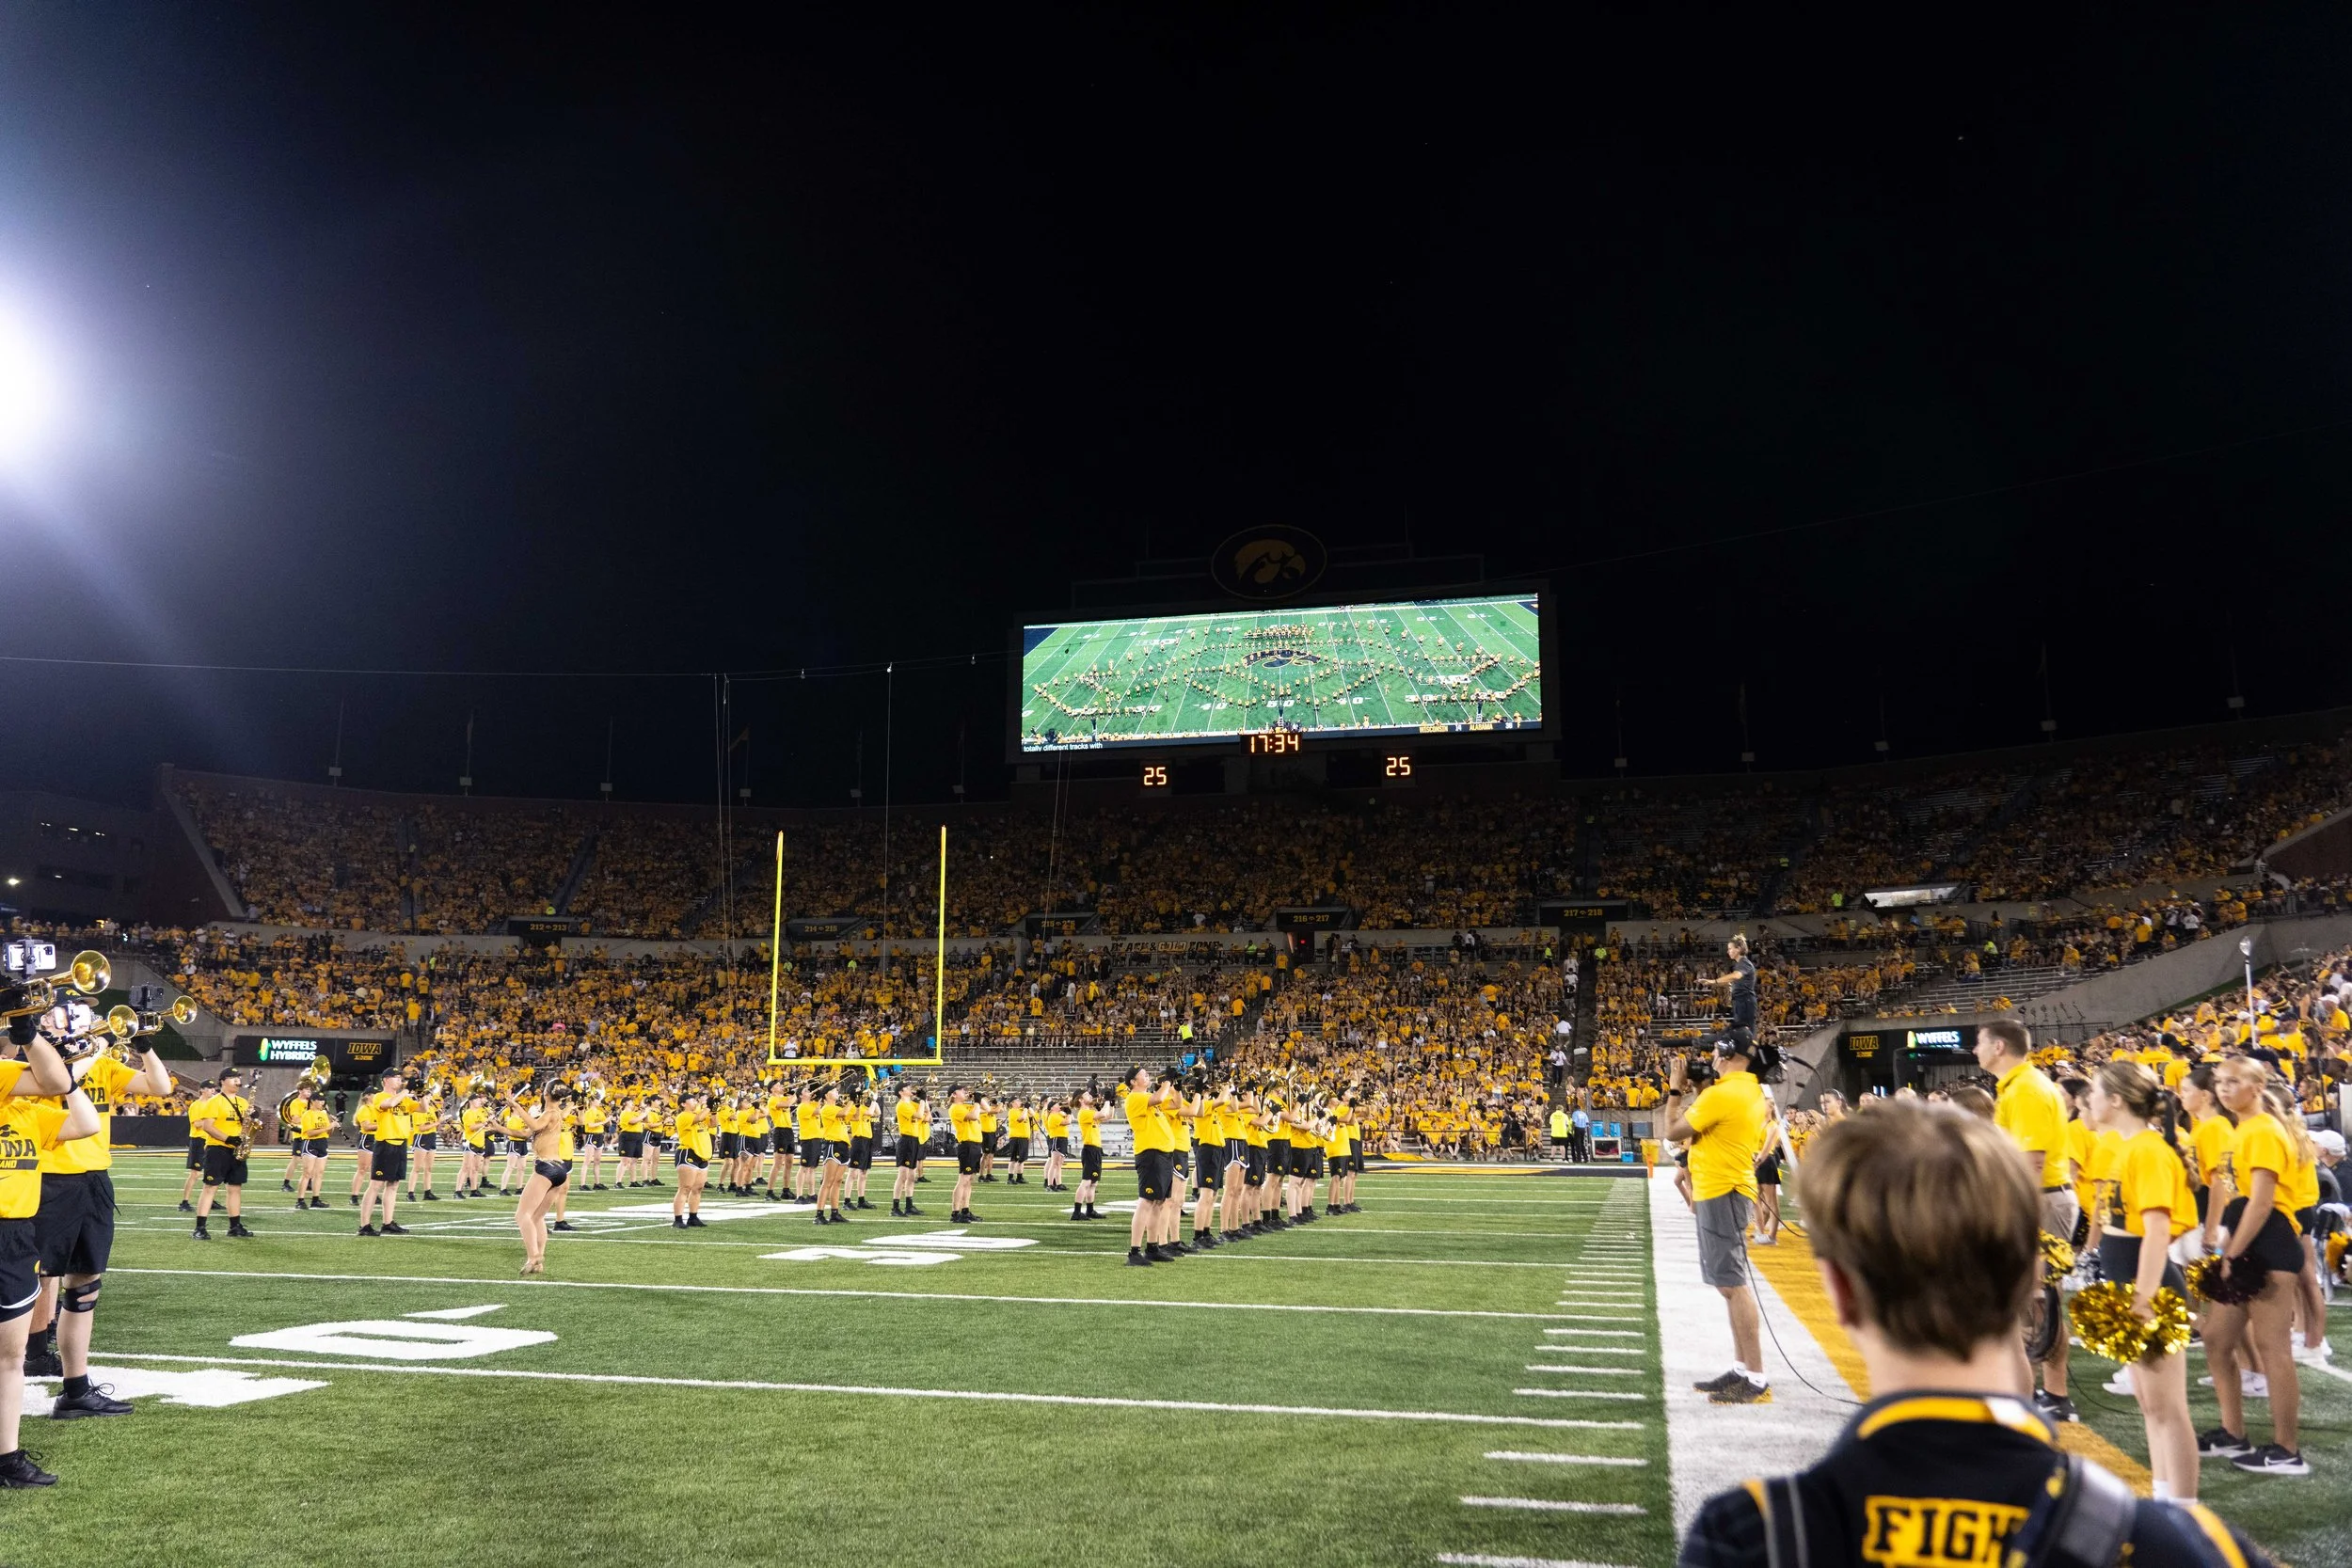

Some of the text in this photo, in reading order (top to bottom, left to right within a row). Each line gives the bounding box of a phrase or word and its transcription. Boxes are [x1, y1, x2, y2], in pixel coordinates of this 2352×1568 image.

[1419, 725, 1449, 734] WISCONSIN
[1470, 722, 1494, 731] ALABAMA
[1249, 734, 1299, 753] 17:34
[1386, 756, 1410, 776] 25
[1143, 767, 1167, 785] 25
[1564, 909, 1579, 917] 217
[1150, 942, 1157, 951] &
[1158, 942, 1187, 952] GOLD
[1850, 1036, 1879, 1051] IOWA
[1915, 1031, 1961, 1044] WYFFELS
[271, 1039, 317, 1051] WYFFELS
[347, 1042, 381, 1054] IOWA
[270, 1051, 317, 1061] HYBRIDS
[0, 1139, 37, 1158] WA
